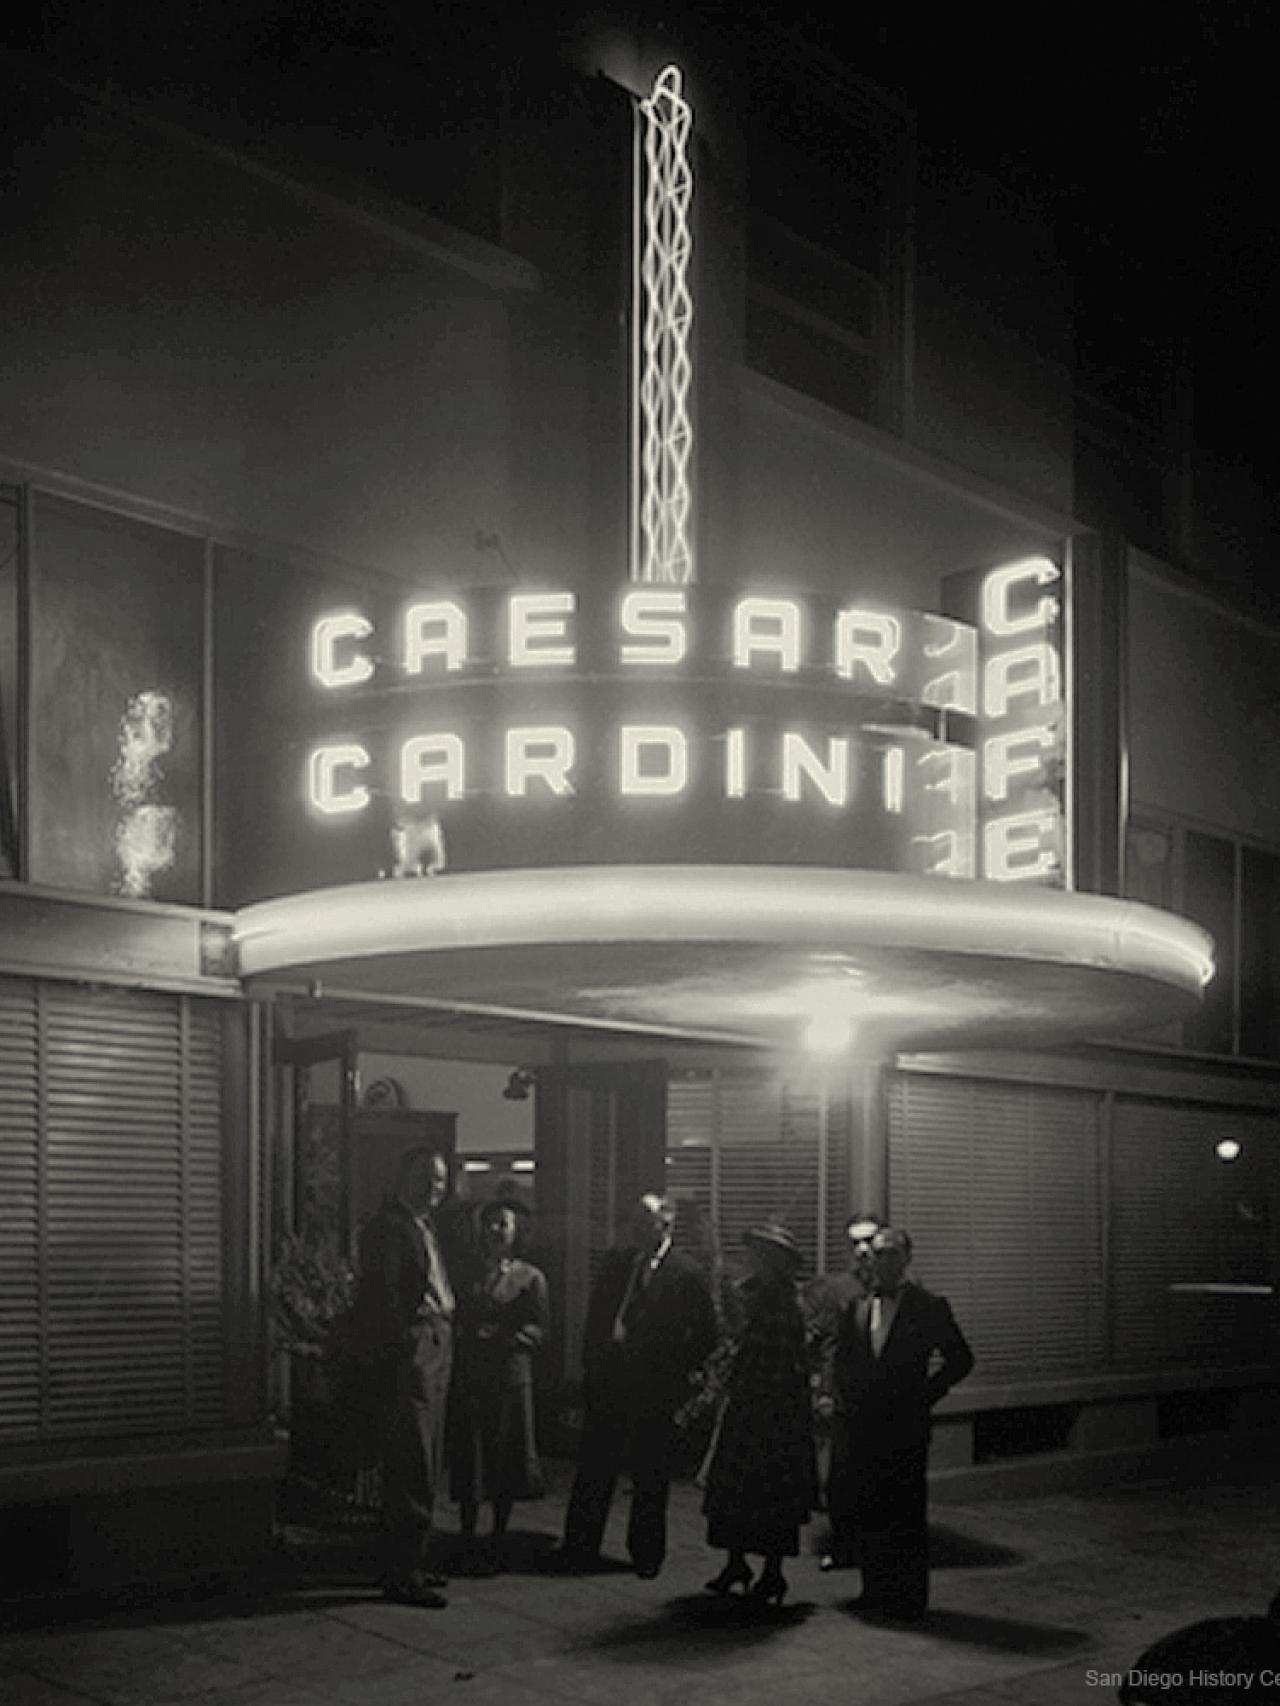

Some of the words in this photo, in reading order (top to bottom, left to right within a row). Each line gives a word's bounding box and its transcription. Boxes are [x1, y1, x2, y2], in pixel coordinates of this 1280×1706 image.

[311, 592, 899, 687] CAESAR
[982, 556, 1060, 880] CAFE
[310, 726, 903, 813] CARDINI
